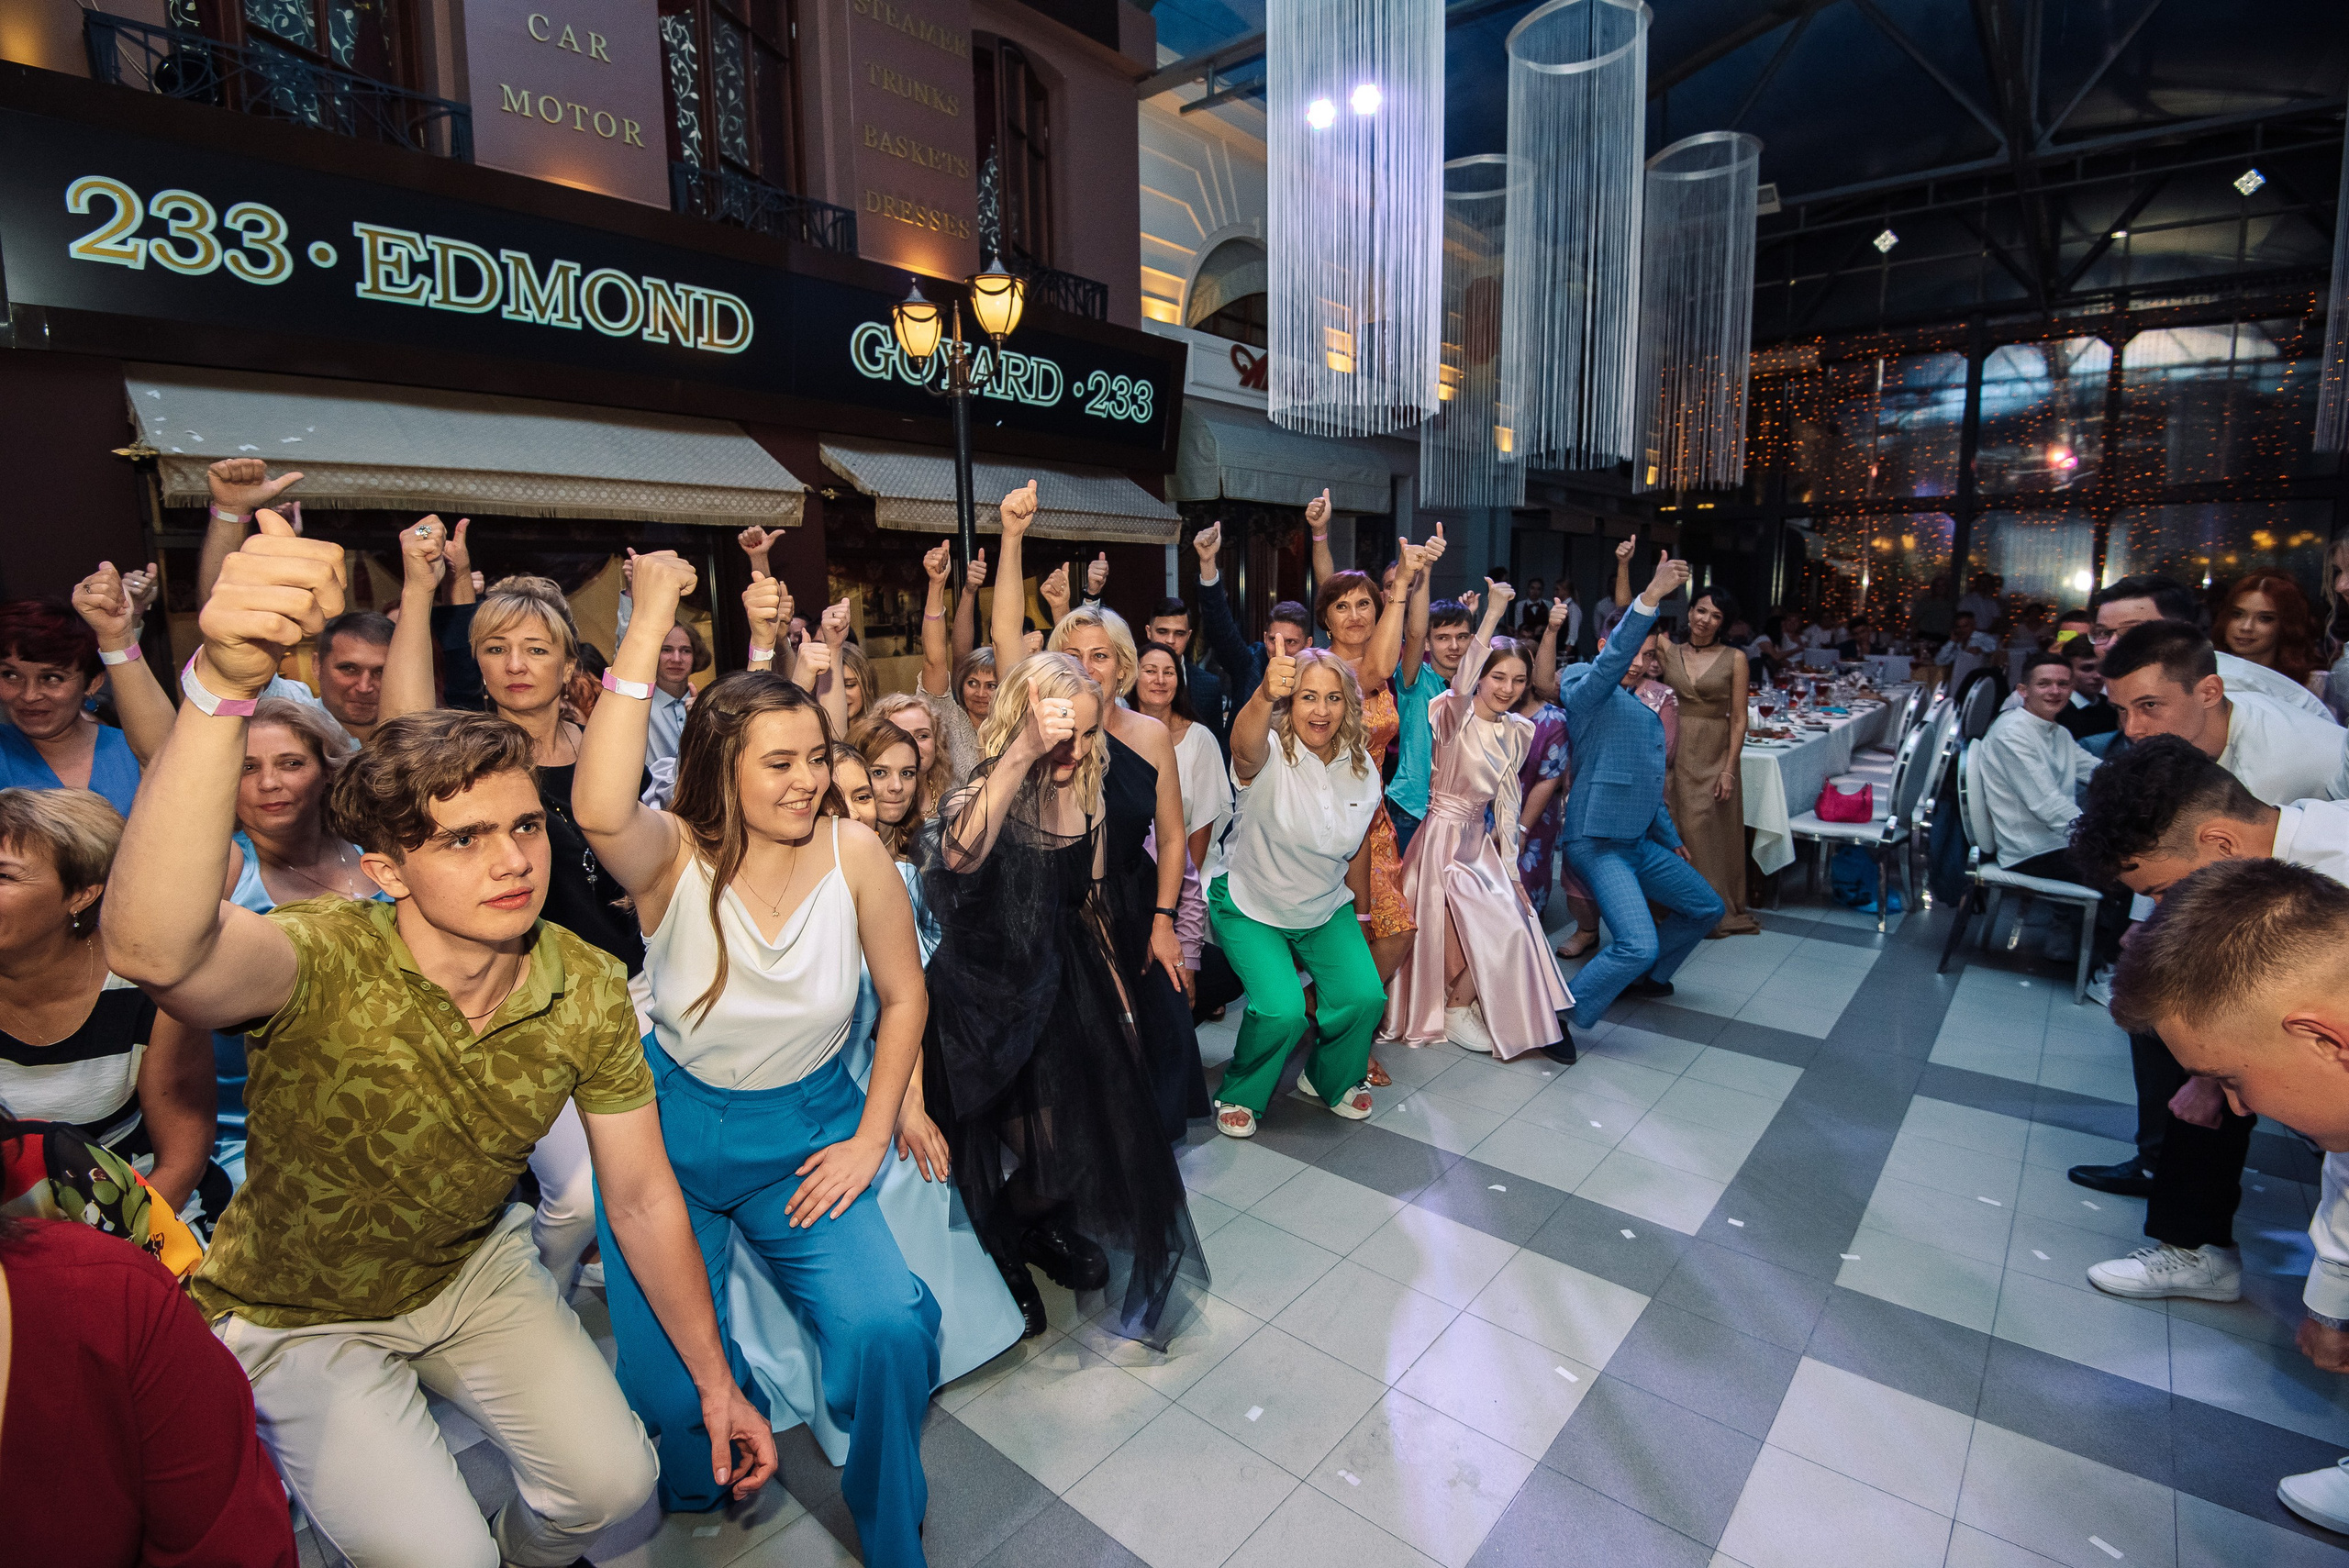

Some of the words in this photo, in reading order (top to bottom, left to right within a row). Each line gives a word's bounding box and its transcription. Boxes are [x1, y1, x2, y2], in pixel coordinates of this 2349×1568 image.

[528, 13, 611, 64] CAR
[854, 0, 969, 59] STEAMER
[500, 83, 645, 148] MOTOR
[864, 61, 960, 117] TRUNKS
[863, 124, 970, 179] BASKETS
[866, 188, 970, 239] DRESSES
[65, 174, 295, 286] 233
[352, 220, 754, 355] EDMOND
